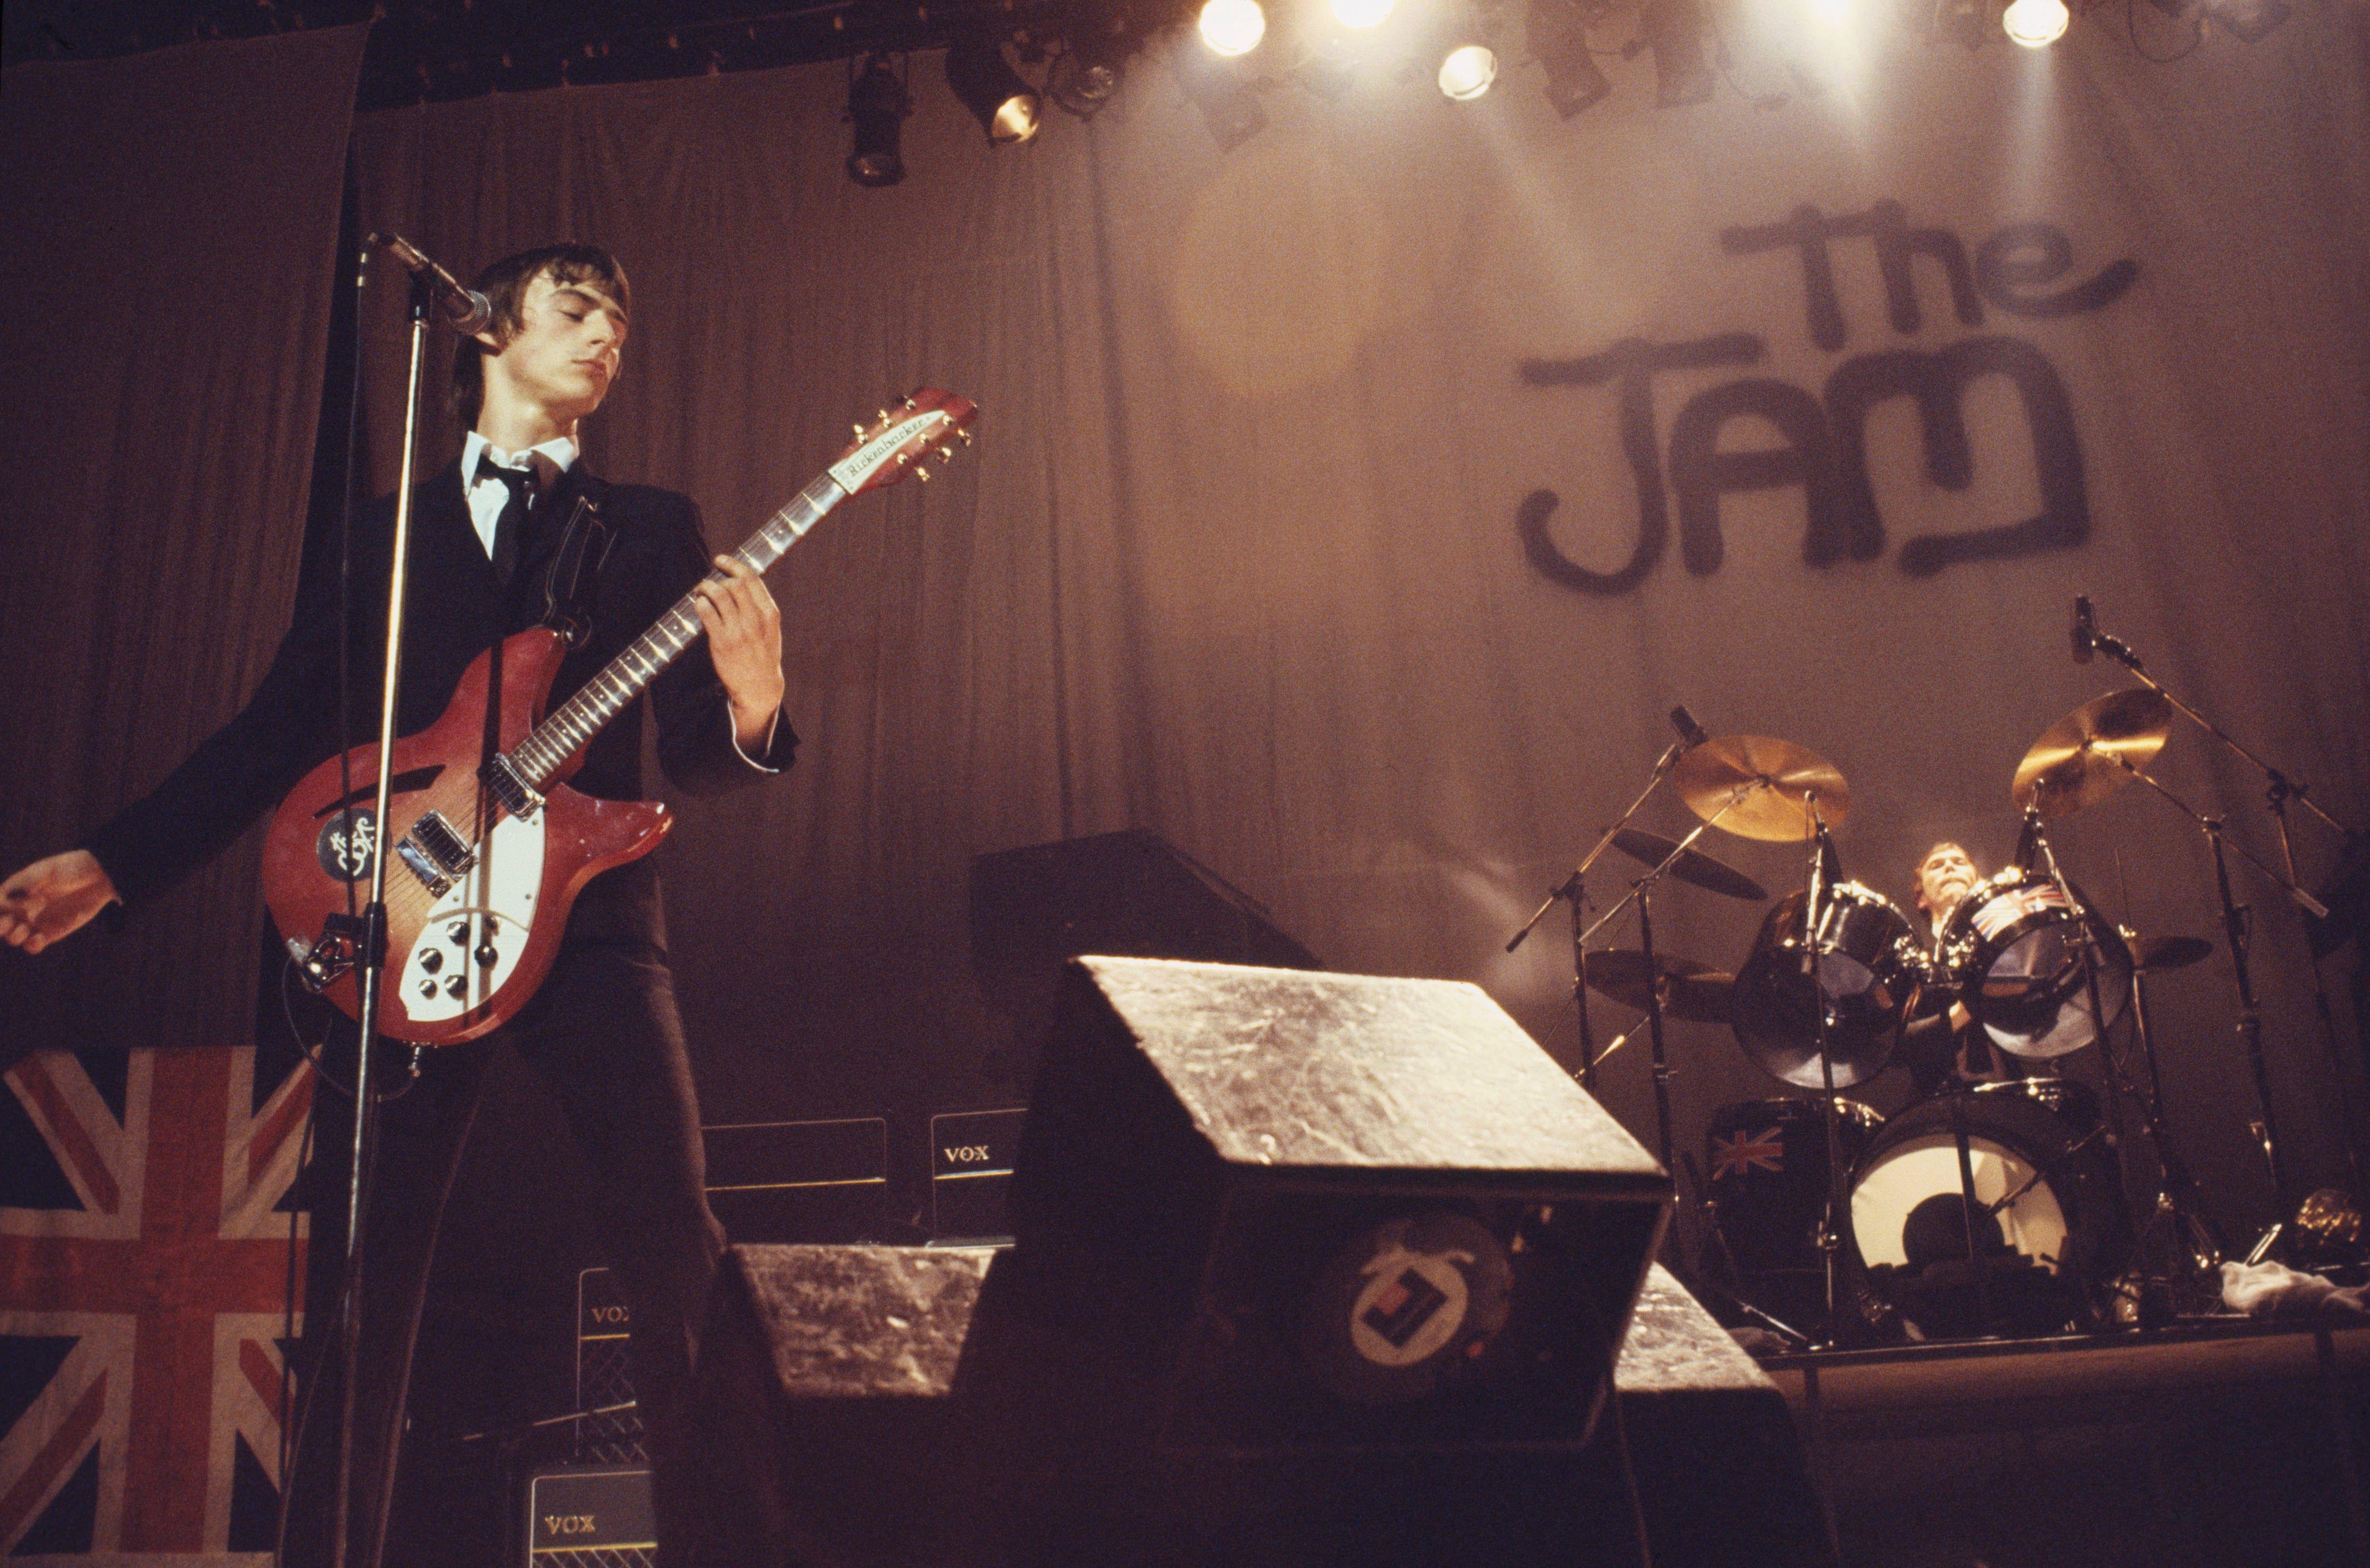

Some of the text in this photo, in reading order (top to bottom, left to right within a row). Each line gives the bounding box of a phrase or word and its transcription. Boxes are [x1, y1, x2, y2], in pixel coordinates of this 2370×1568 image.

[1719, 199, 2138, 353] The
[944, 1145, 990, 1162] VOX
[545, 1515, 596, 1535] VOX
